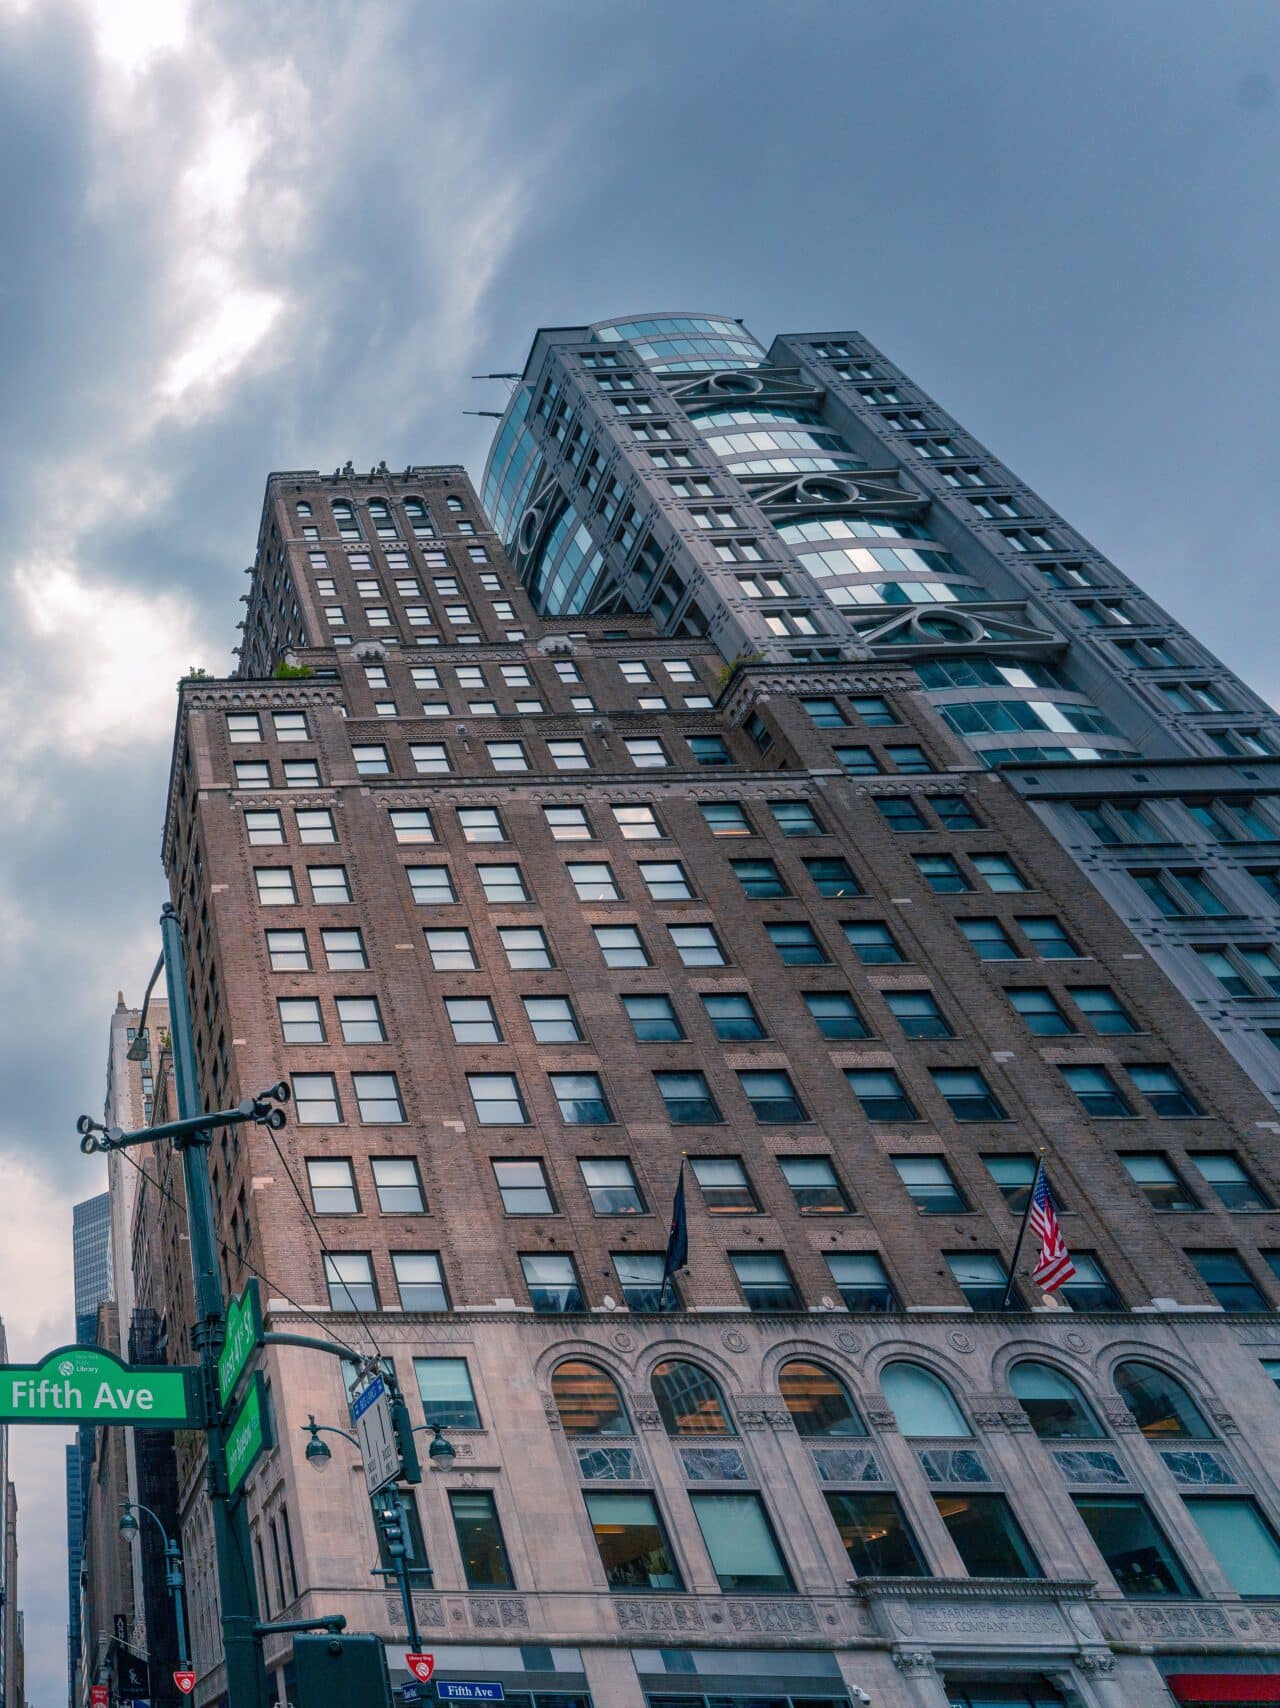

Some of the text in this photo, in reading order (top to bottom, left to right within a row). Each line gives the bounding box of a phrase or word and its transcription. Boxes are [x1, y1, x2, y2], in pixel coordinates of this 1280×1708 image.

[76, 1366, 99, 1374] Library
[11, 1379, 154, 1410] Fifth Ave
[955, 1621, 1009, 1632] COMPANY
[447, 1685, 493, 1697] Fifth Ave
